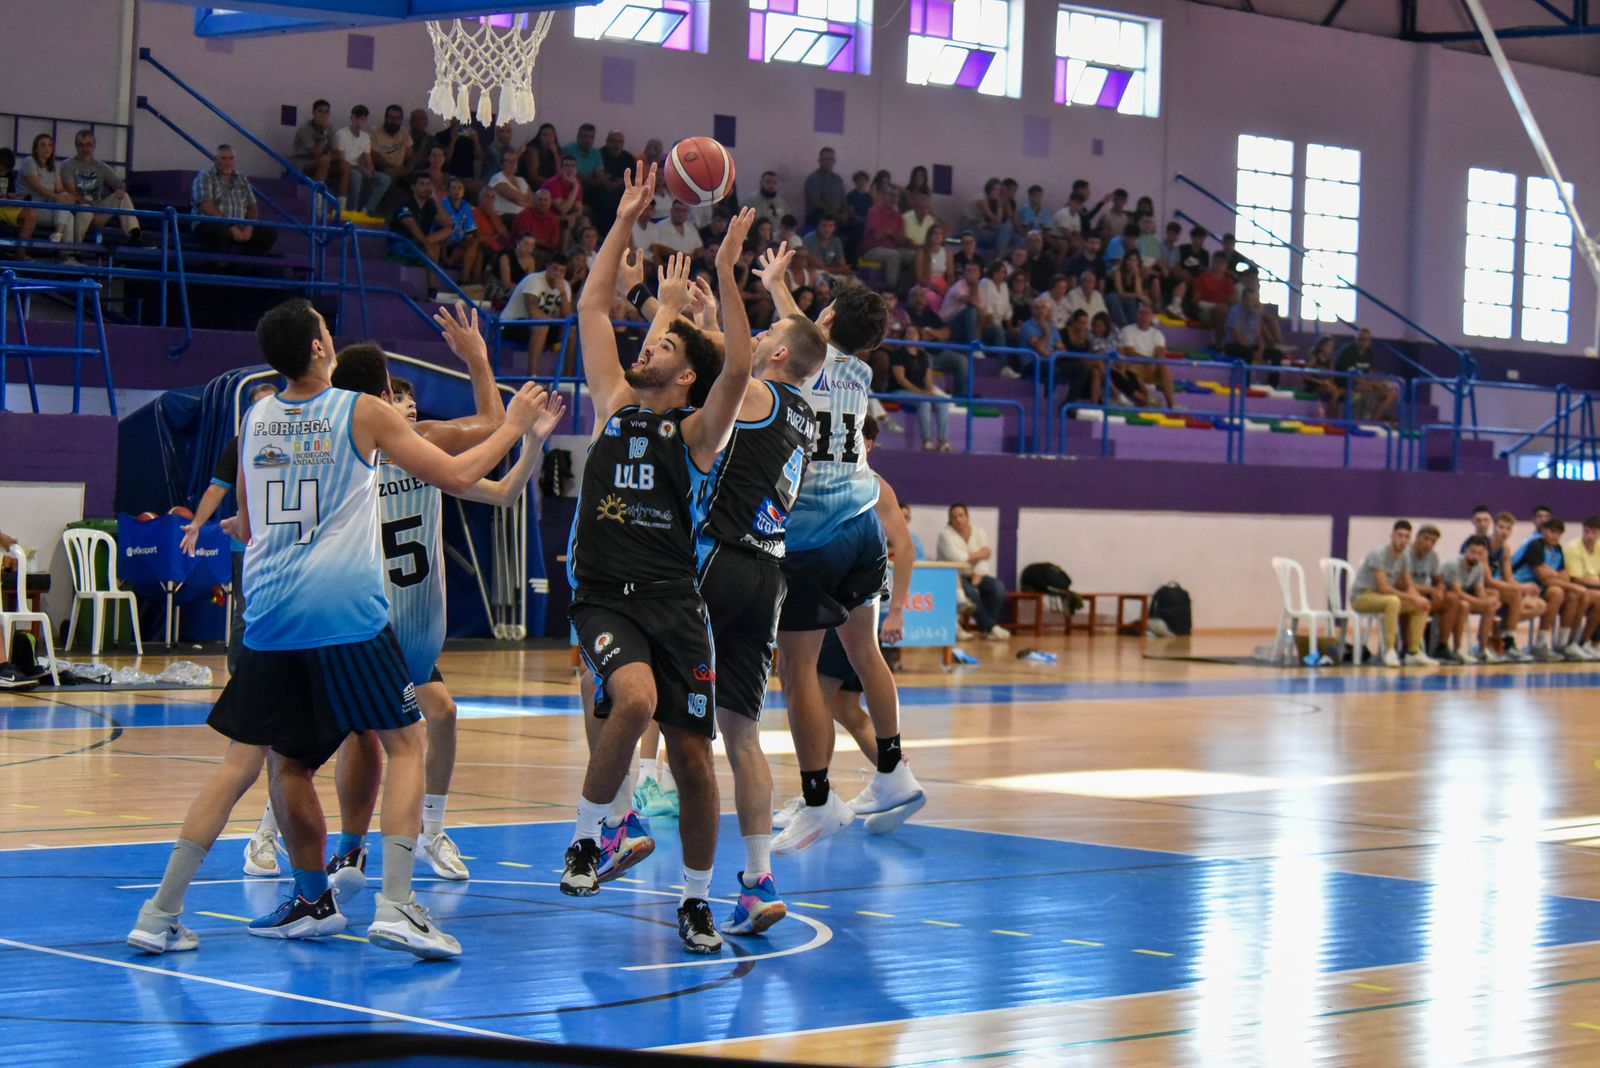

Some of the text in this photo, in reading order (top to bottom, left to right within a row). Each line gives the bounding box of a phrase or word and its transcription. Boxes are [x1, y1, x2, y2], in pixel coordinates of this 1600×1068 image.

[254, 418, 331, 436] P.ORTEGA
[811, 411, 858, 463] 11
[628, 436, 649, 459] 18
[614, 463, 655, 490] ULB
[782, 445, 805, 498] 4
[378, 477, 430, 497] ZQUE
[266, 478, 320, 546] 4
[380, 514, 430, 589] 5
[687, 692, 708, 718] 18
